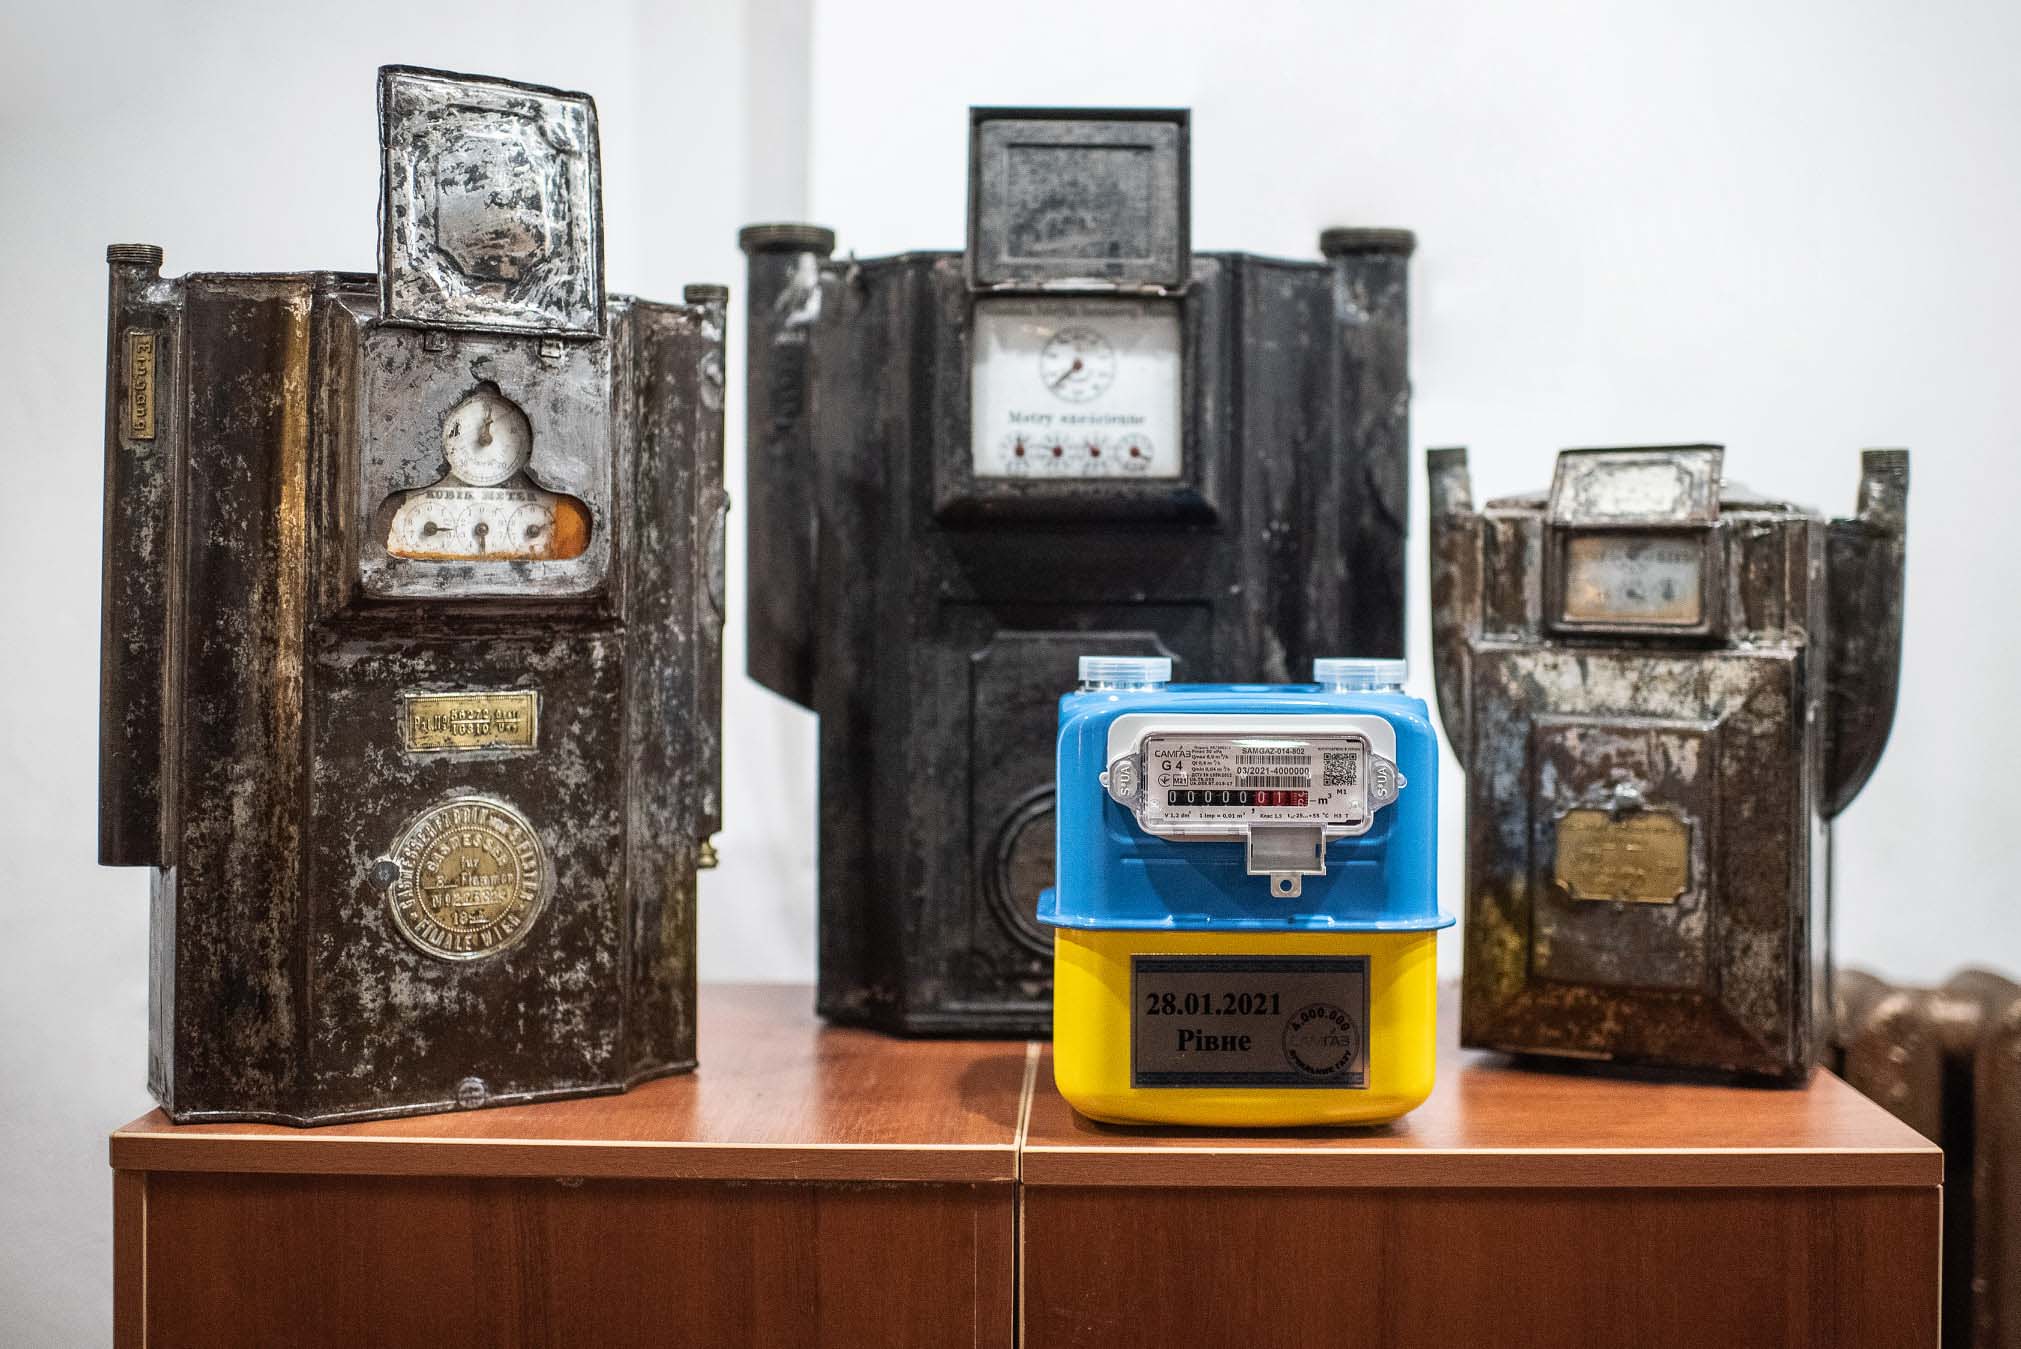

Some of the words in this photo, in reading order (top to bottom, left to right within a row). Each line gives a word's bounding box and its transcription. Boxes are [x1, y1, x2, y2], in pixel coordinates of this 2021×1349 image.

[134, 343, 152, 431] Eingang
[1162, 760, 1172, 771] G
[1175, 760, 1183, 771] 4
[1236, 767, 1310, 775] 03/2021-4000000
[1146, 992, 1281, 1016] 28.01.2021
[1177, 1029, 1252, 1052] Рівне
